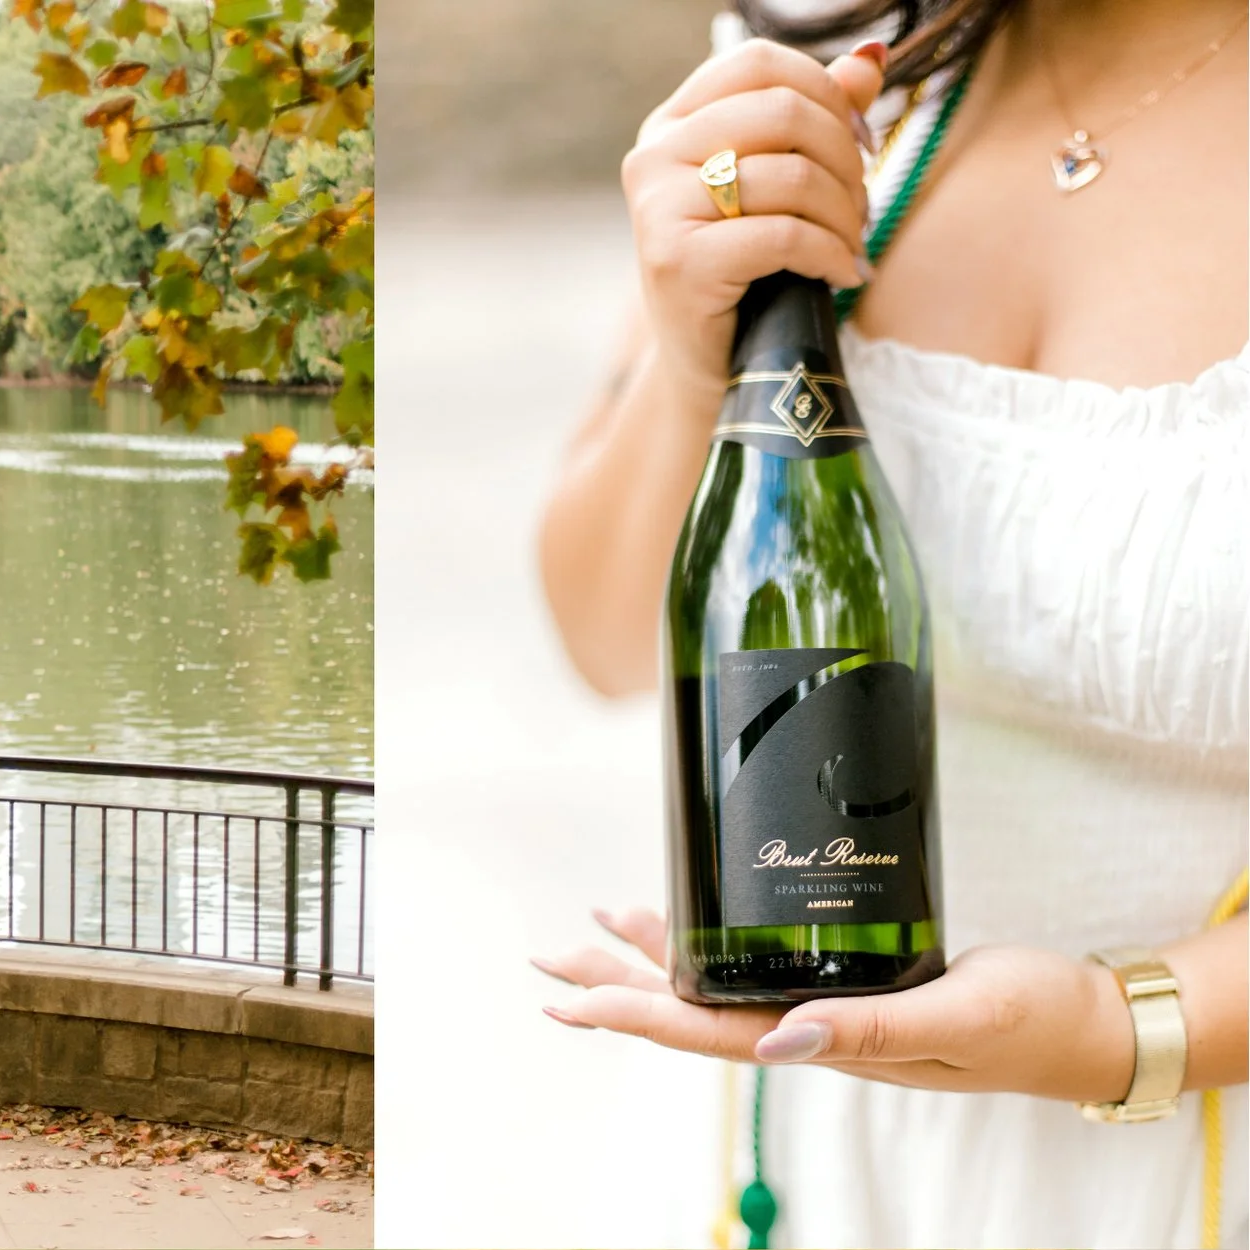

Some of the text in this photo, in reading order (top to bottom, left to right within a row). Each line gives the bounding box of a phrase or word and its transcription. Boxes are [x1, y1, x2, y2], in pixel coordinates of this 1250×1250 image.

[752, 836, 900, 868] Brut Reserve
[774, 882, 885, 895] SPARKLING WINE
[806, 899, 854, 909] AMERICAN
